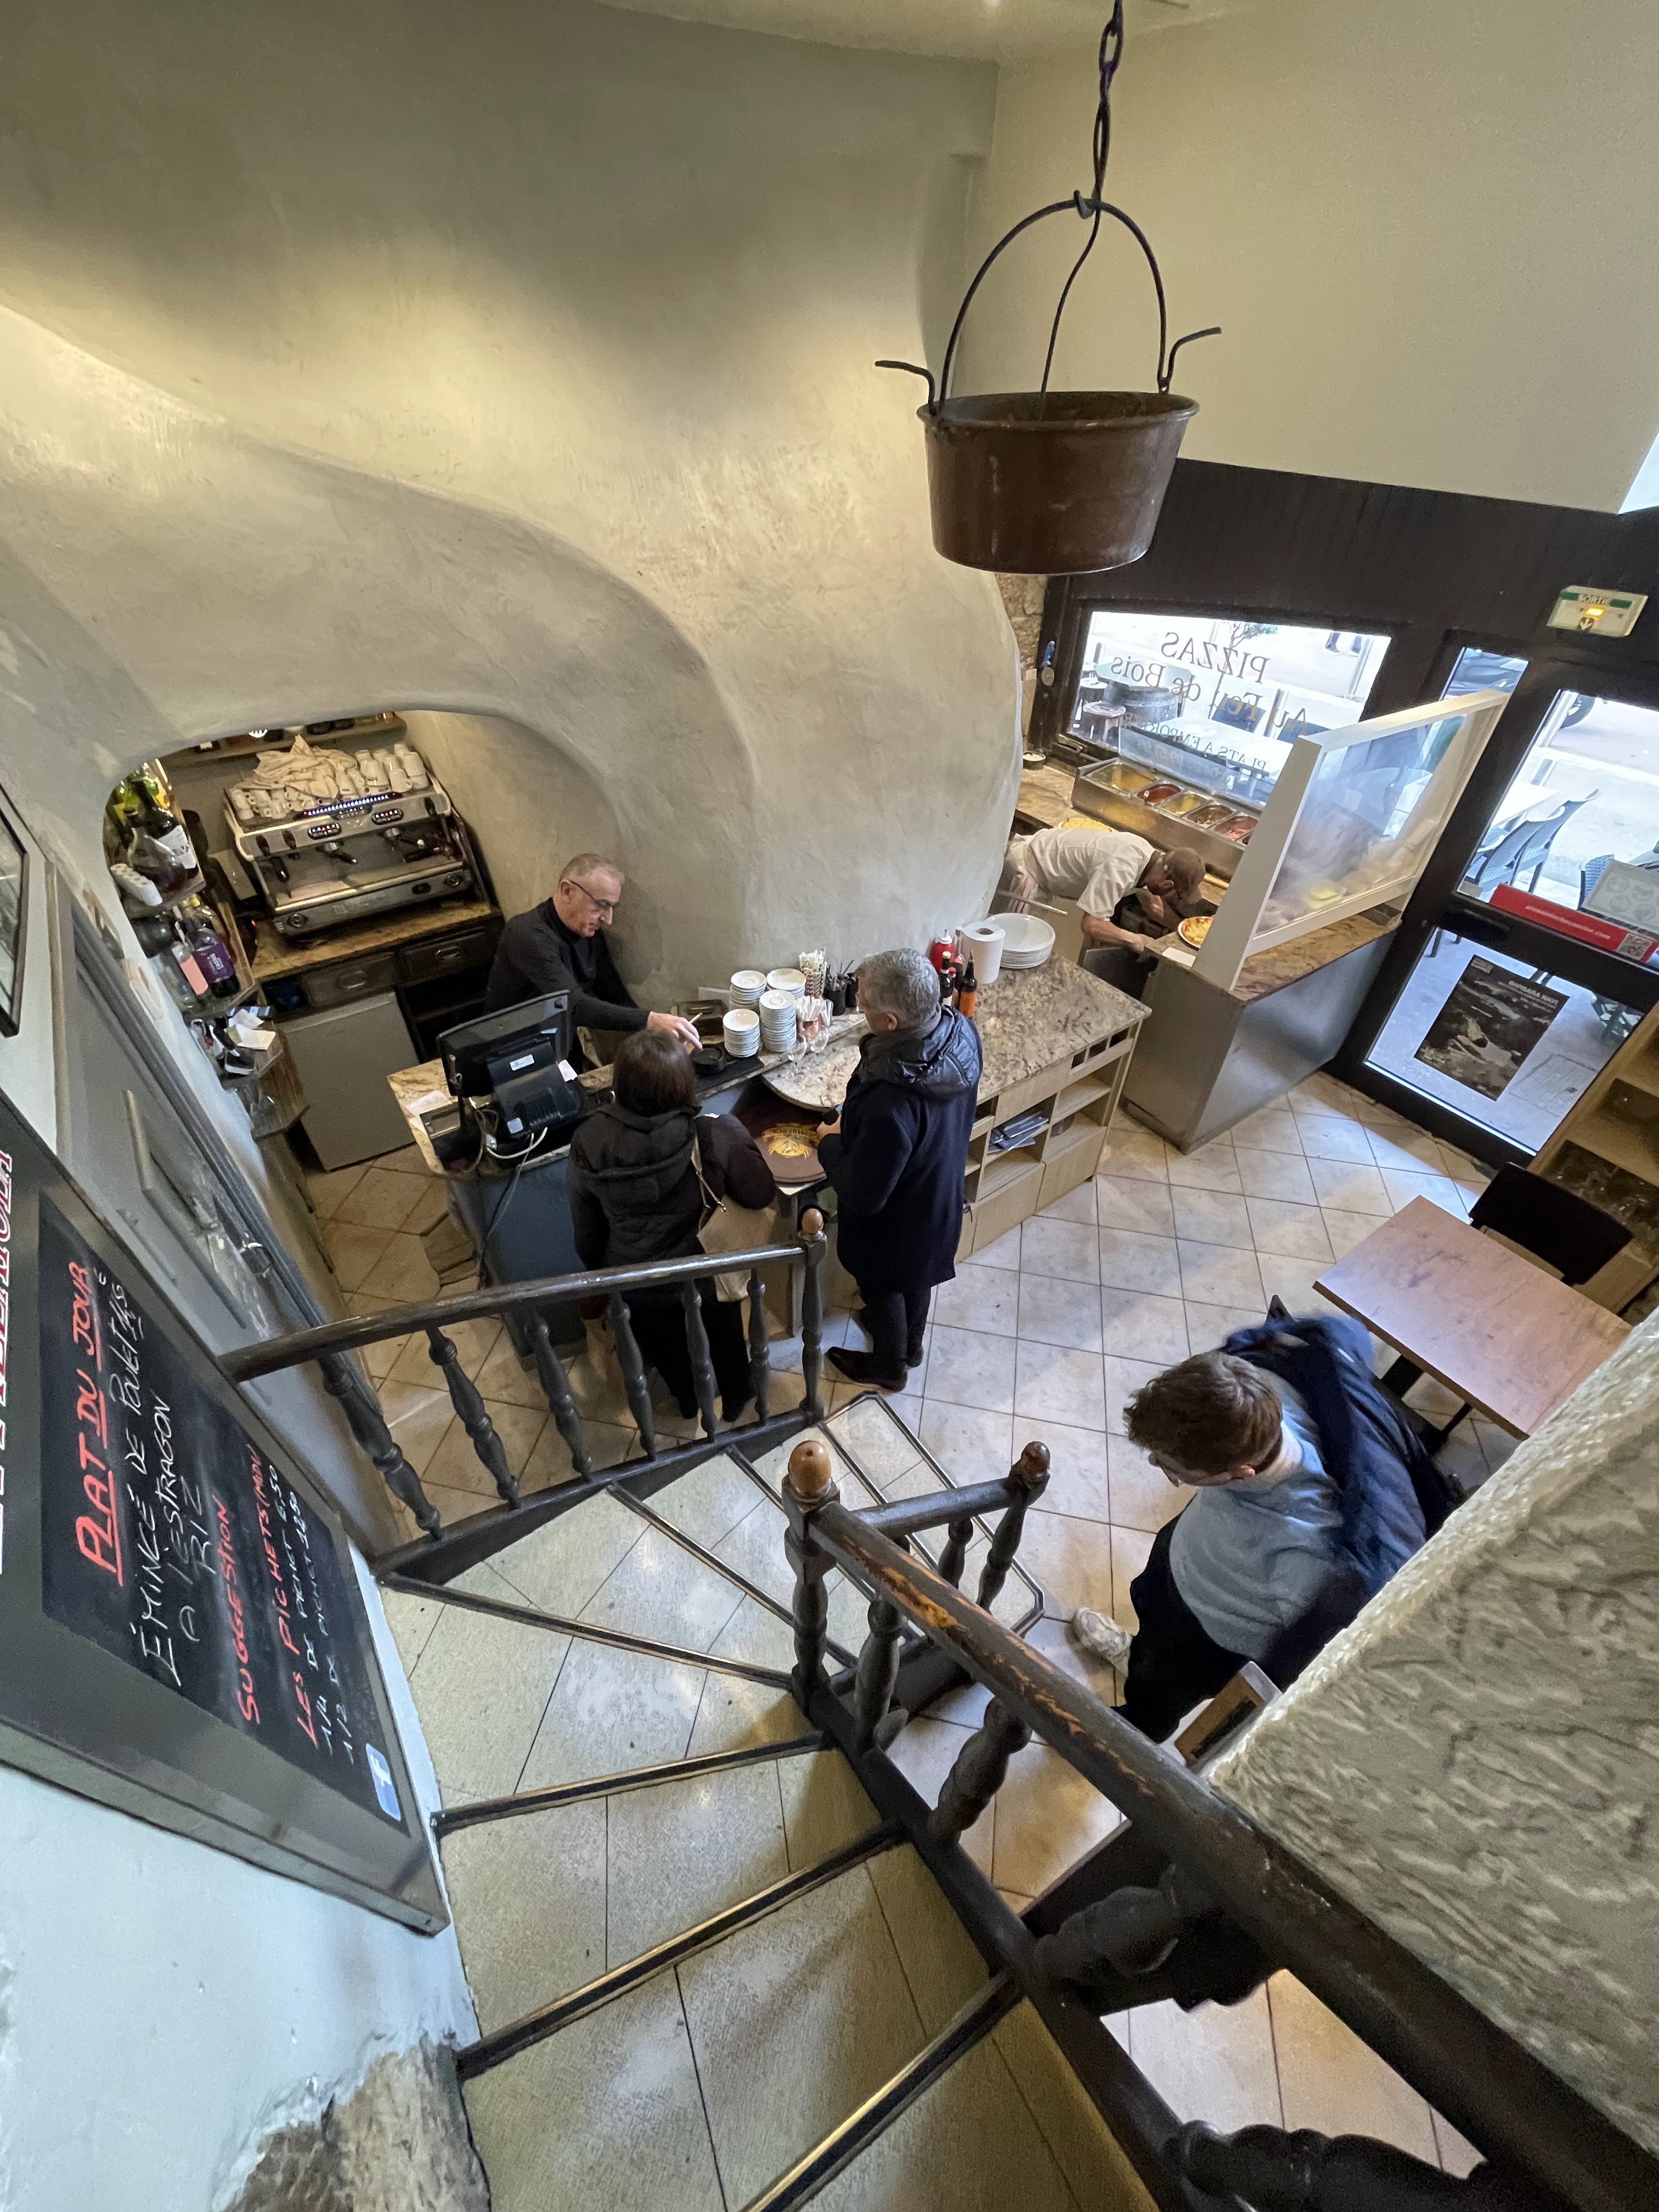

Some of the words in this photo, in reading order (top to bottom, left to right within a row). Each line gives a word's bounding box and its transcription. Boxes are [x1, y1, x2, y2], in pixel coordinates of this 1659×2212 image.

[69, 1261, 95, 1356] JOUR
[76, 1368, 100, 1437] DU
[76, 1432, 119, 1574] PLAT
[182, 1475, 217, 1578] RIZ
[292, 1671, 318, 1749] LES
